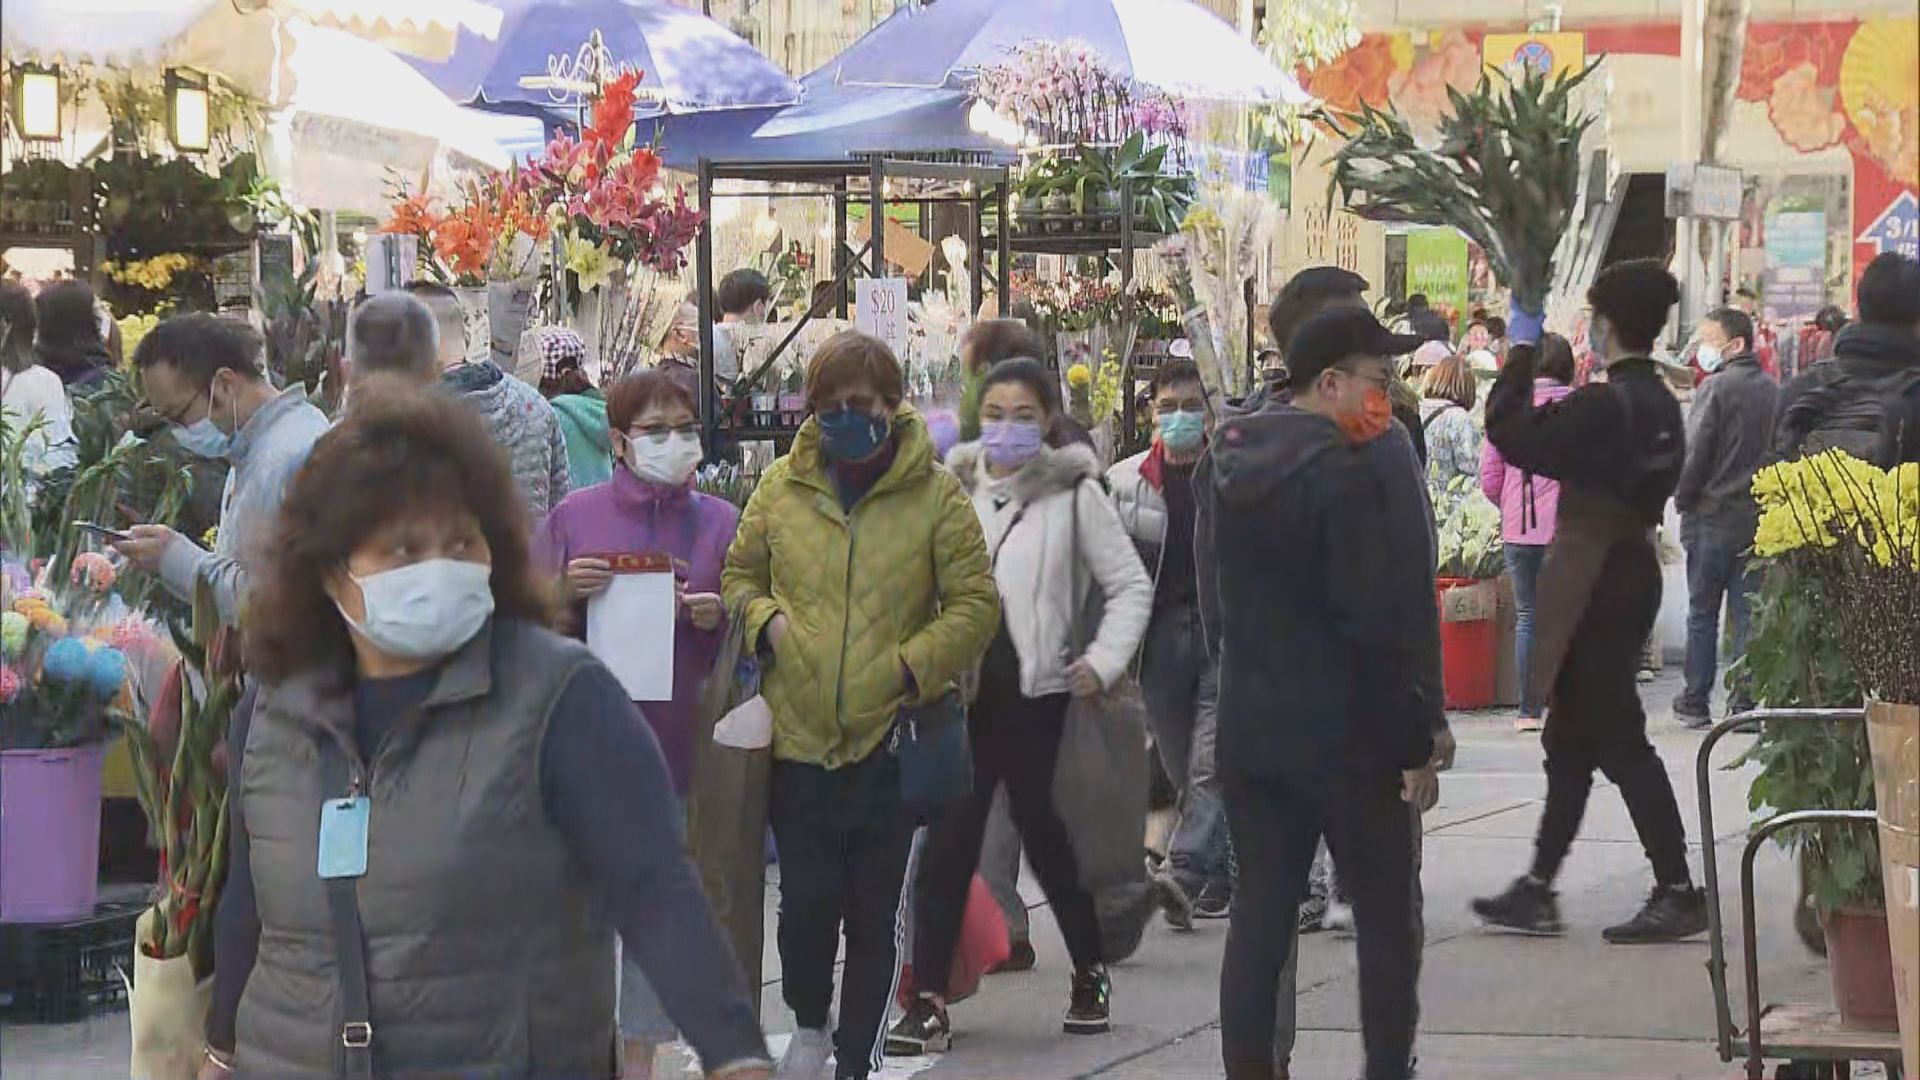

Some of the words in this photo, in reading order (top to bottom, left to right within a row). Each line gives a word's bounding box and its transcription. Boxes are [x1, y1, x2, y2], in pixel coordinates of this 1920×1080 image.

[1415, 263, 1457, 282] ENJOY
[1413, 282, 1458, 297] NATURE
[871, 289, 895, 317] $20
